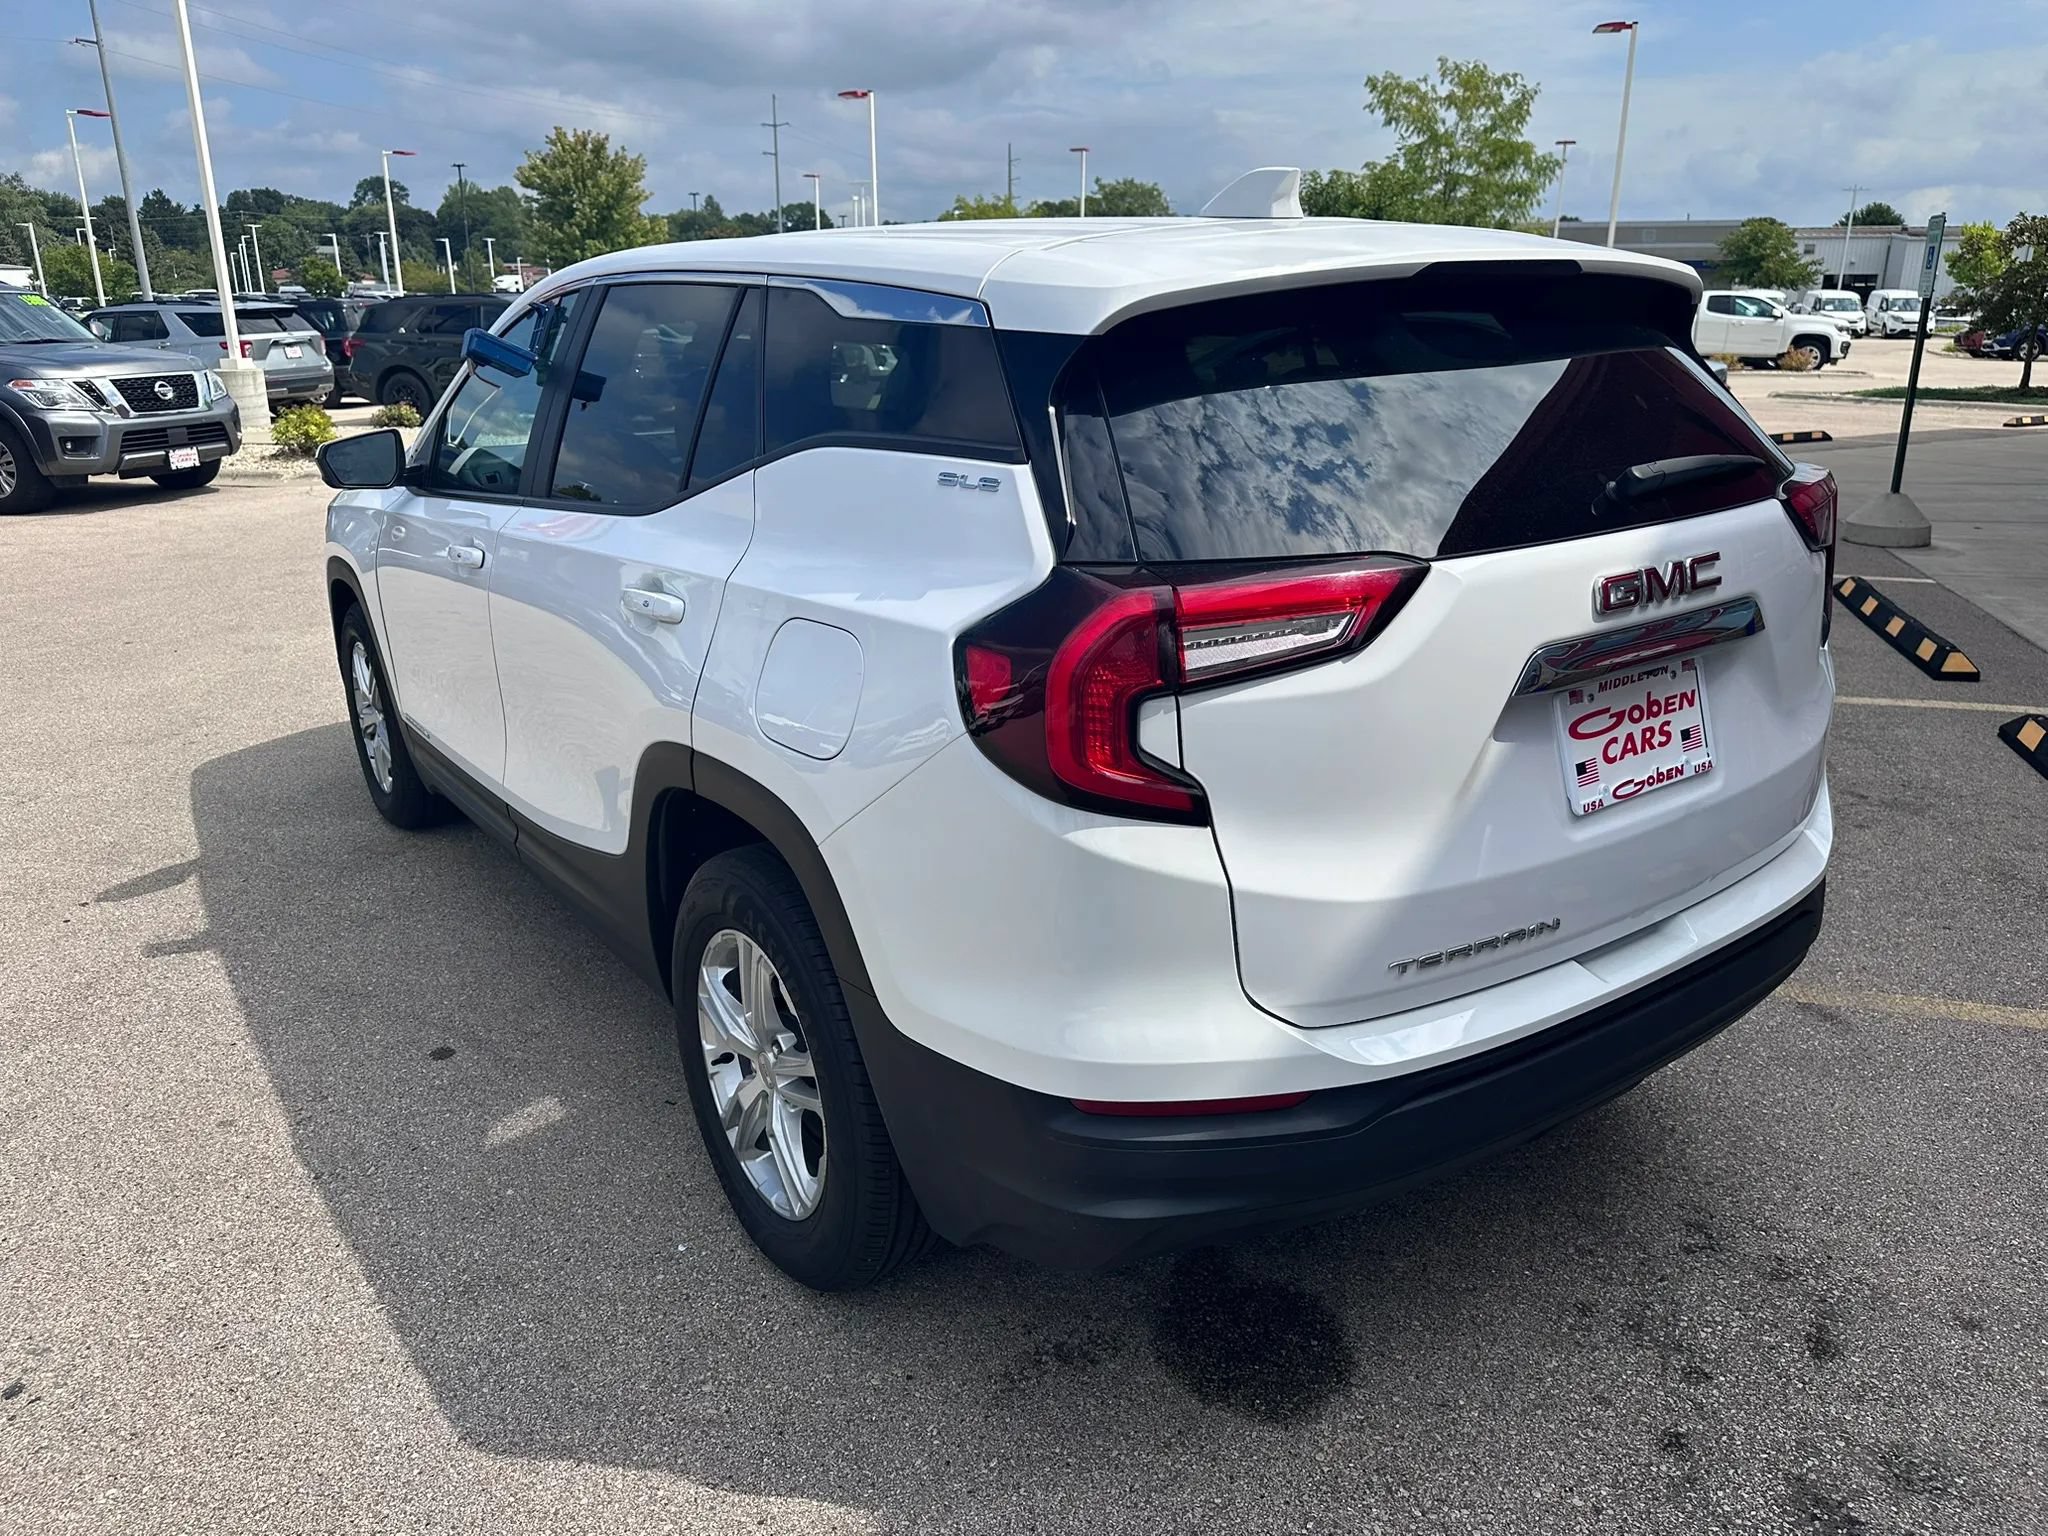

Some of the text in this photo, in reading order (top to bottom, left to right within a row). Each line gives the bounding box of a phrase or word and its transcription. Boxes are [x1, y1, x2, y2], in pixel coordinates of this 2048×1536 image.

[1593, 552, 1722, 615] GMC
[1598, 665, 1669, 693] MIDDLETON
[1602, 720, 1672, 764] CARS
[1583, 799, 1604, 813] USA
[1694, 760, 1713, 774] USA
[1387, 917, 1560, 975] TERRAIN
